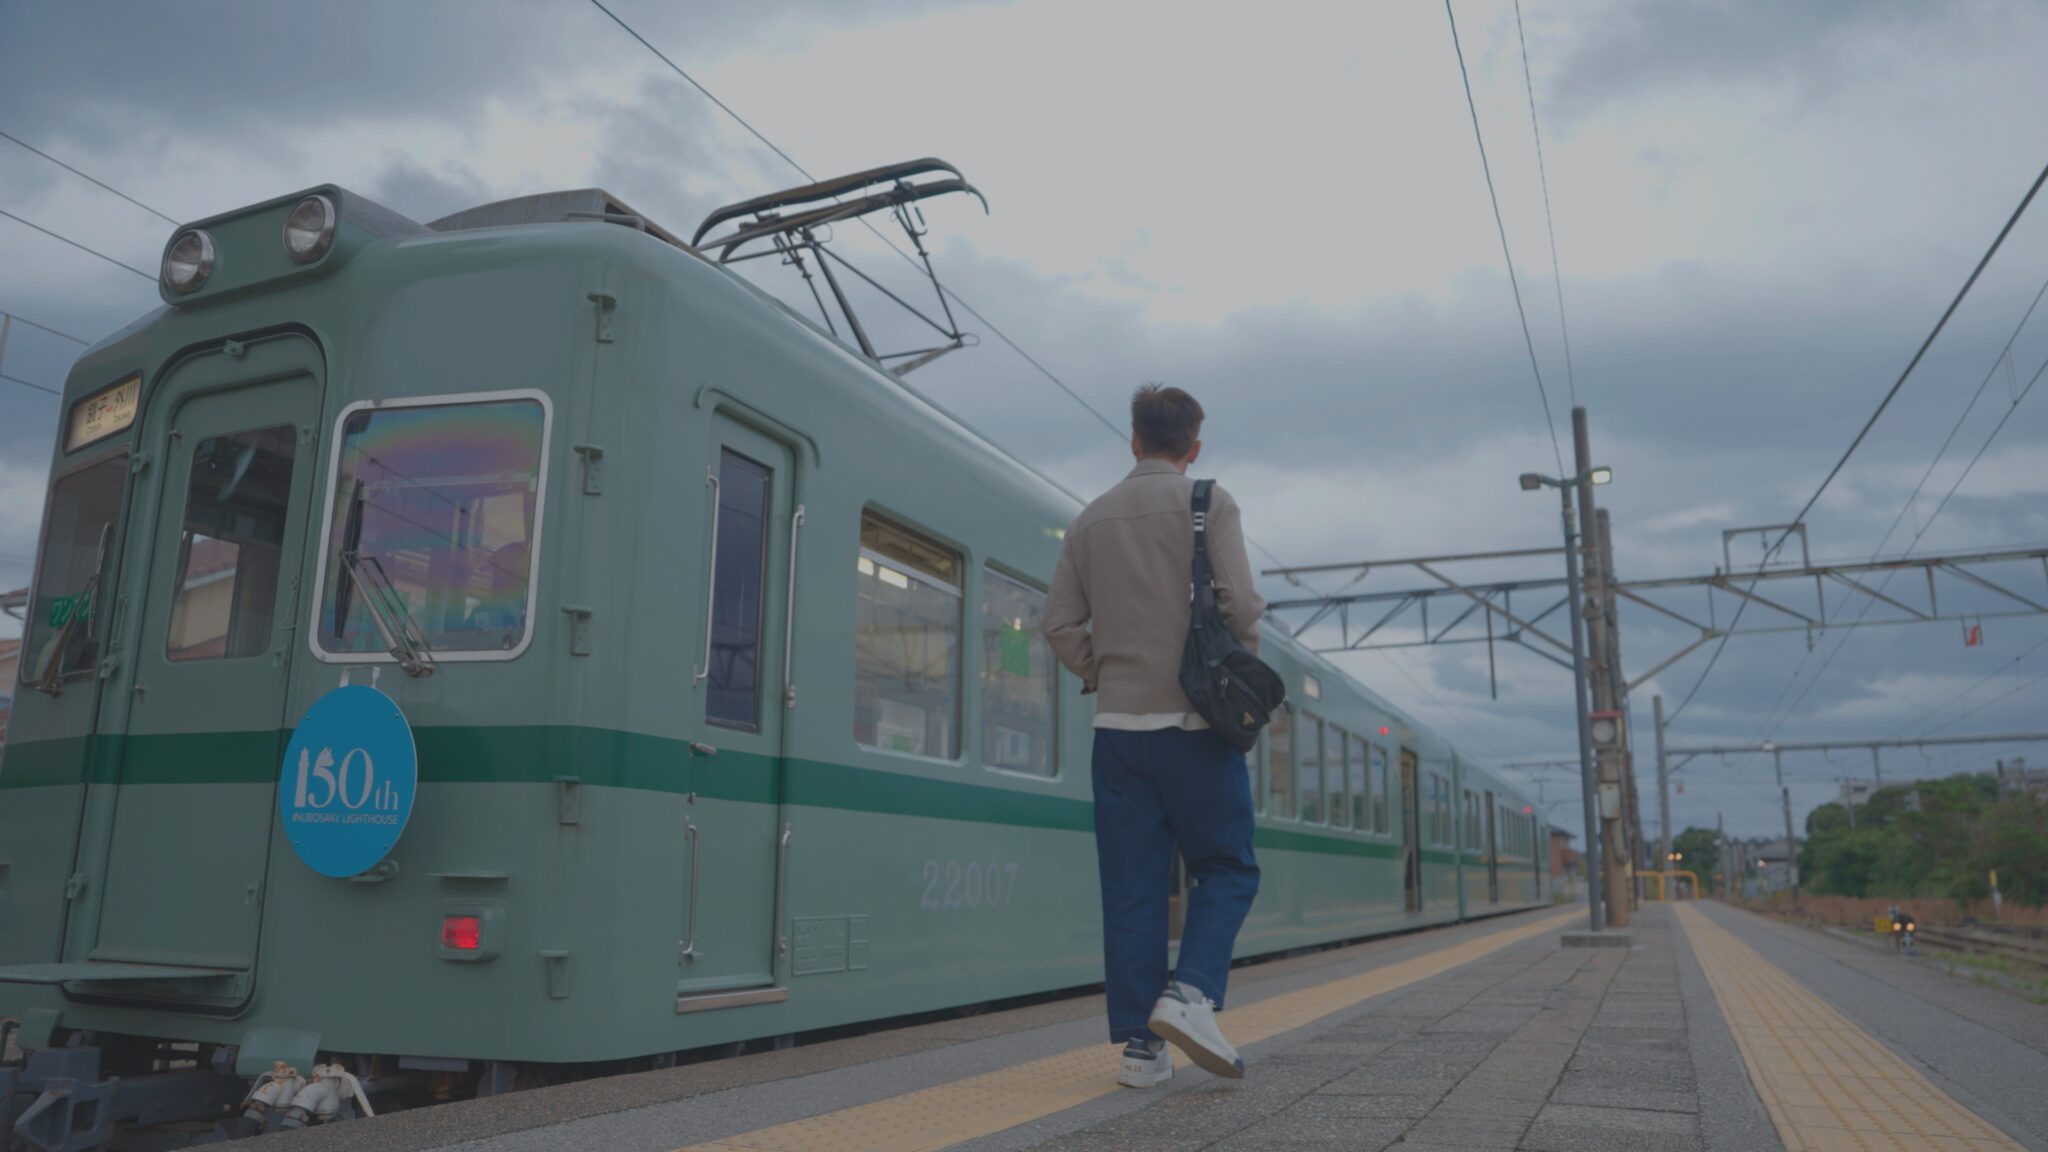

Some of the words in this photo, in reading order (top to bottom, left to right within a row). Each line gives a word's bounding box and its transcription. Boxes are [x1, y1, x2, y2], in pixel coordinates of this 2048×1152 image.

[52, 593, 90, 623] ワンン
[292, 812, 339, 824] INUBOSAKI
[342, 814, 399, 825] LIGHTHOUSE
[920, 859, 1019, 909] 22007
